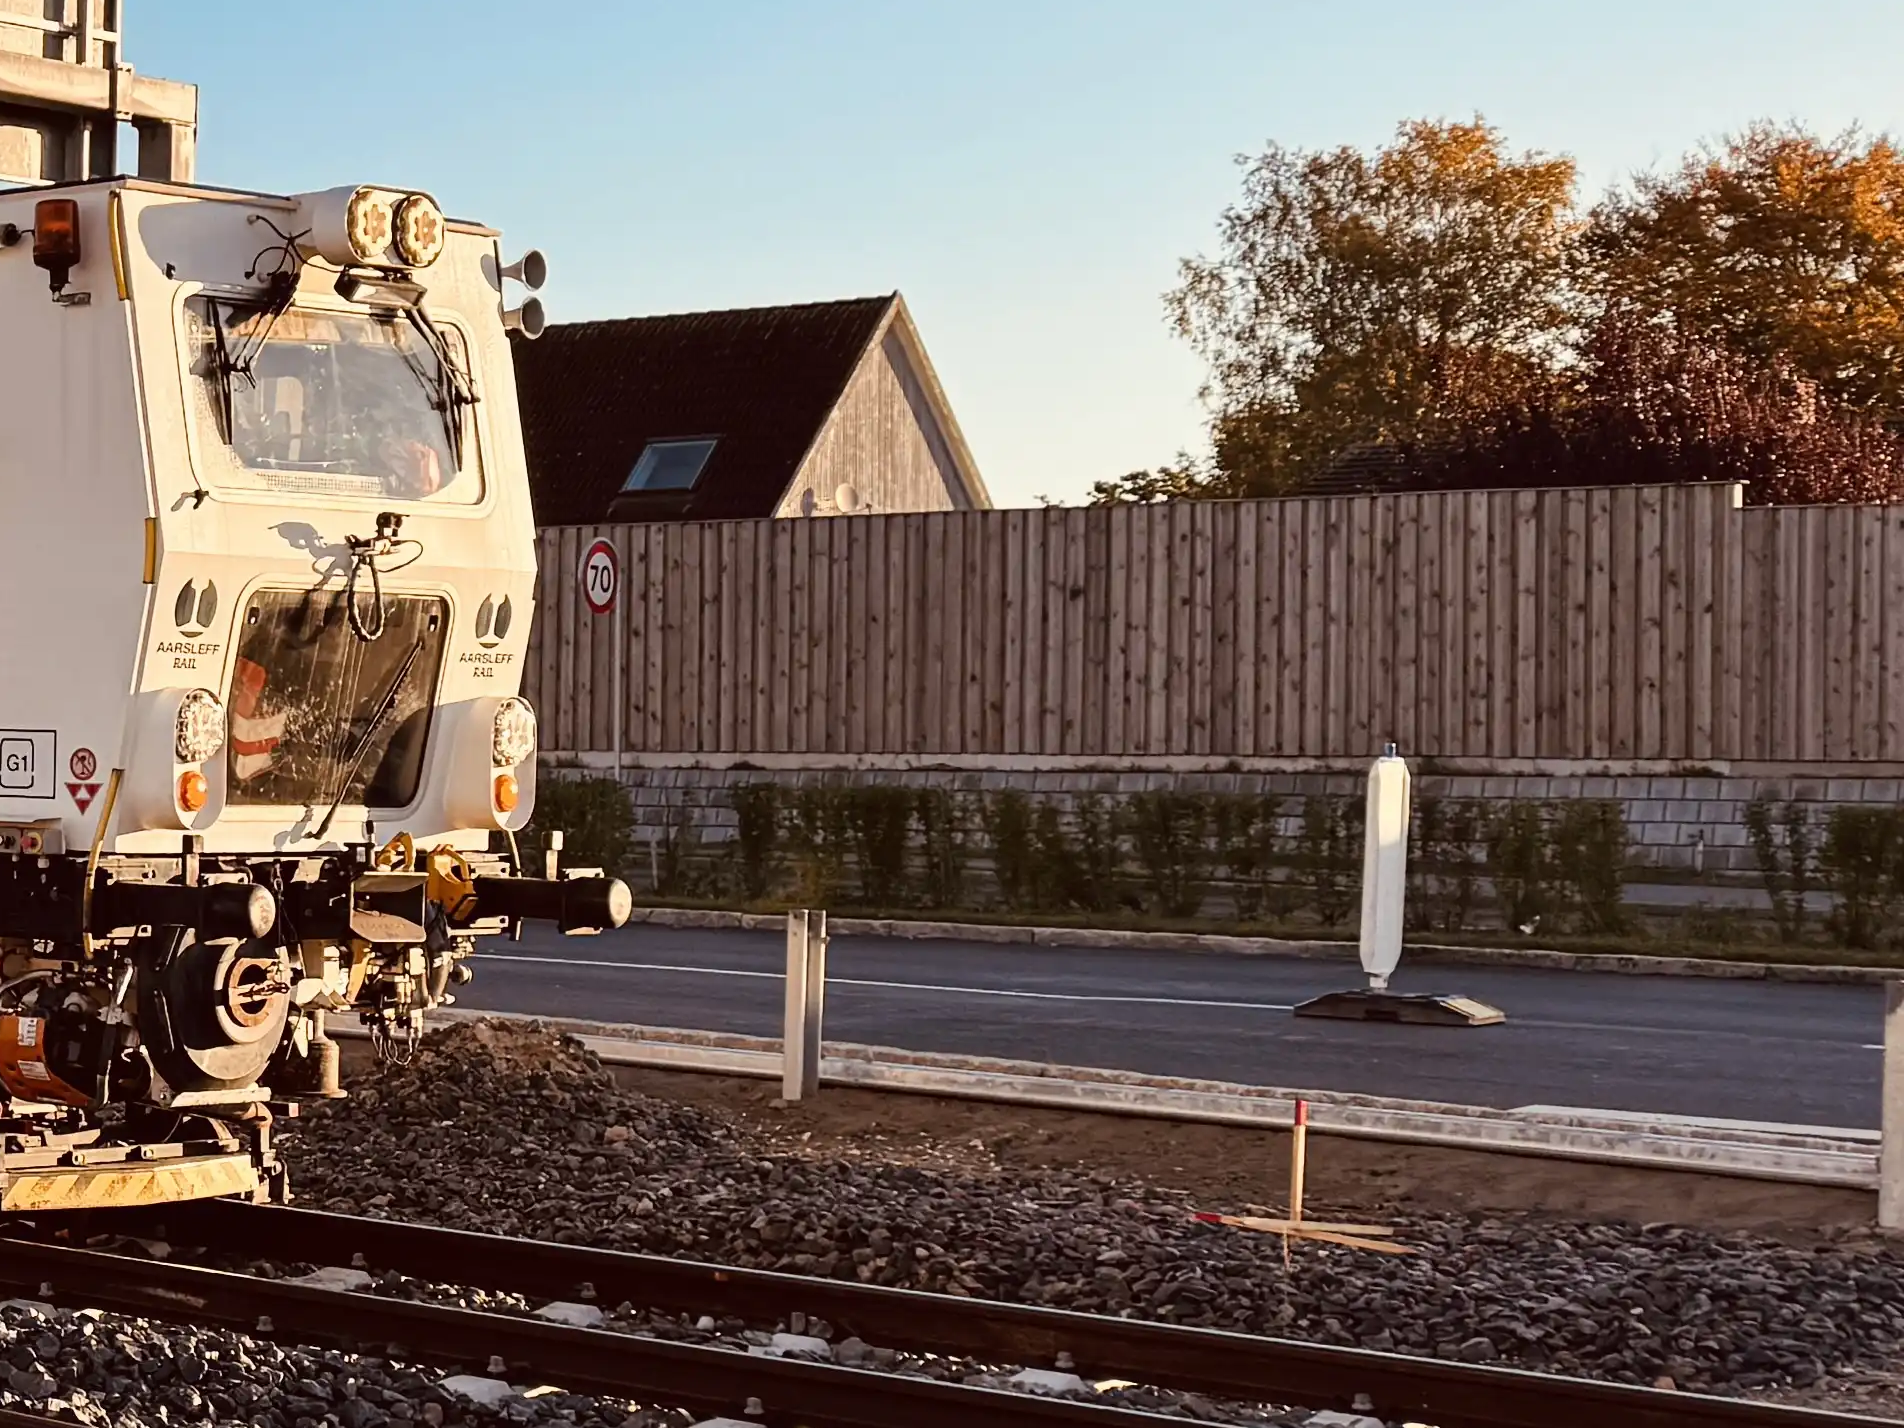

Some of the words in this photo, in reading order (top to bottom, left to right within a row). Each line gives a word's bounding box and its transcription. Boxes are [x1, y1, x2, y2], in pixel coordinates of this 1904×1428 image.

[590, 565, 611, 593] 70
[156, 641, 220, 655] AARSLEFF
[173, 657, 197, 669] RAIL
[459, 652, 514, 664] AARSLEFF
[6, 753, 28, 772] G1
